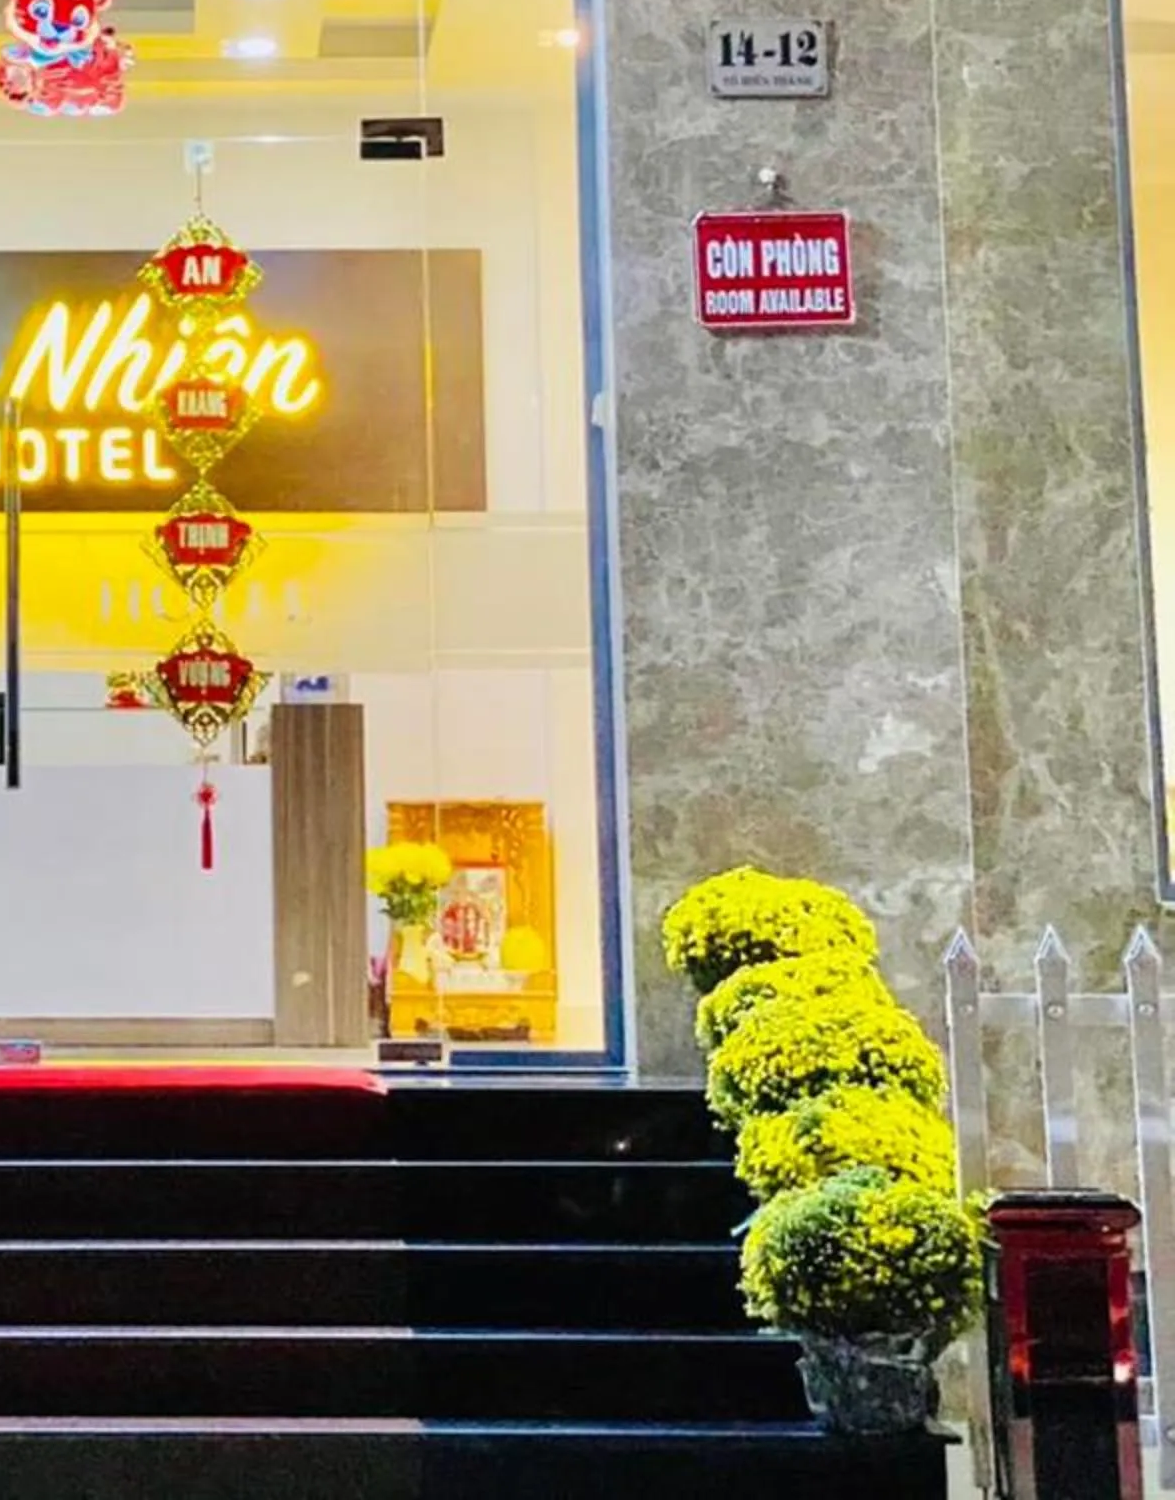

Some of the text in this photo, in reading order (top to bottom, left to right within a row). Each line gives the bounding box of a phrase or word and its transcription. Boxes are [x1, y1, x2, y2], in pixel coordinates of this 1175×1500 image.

[719, 29, 818, 67] 14-12
[182, 255, 221, 285] AN
[706, 231, 840, 279] CÒN PHÒNG
[705, 287, 845, 315] ROOM AVAILABLE
